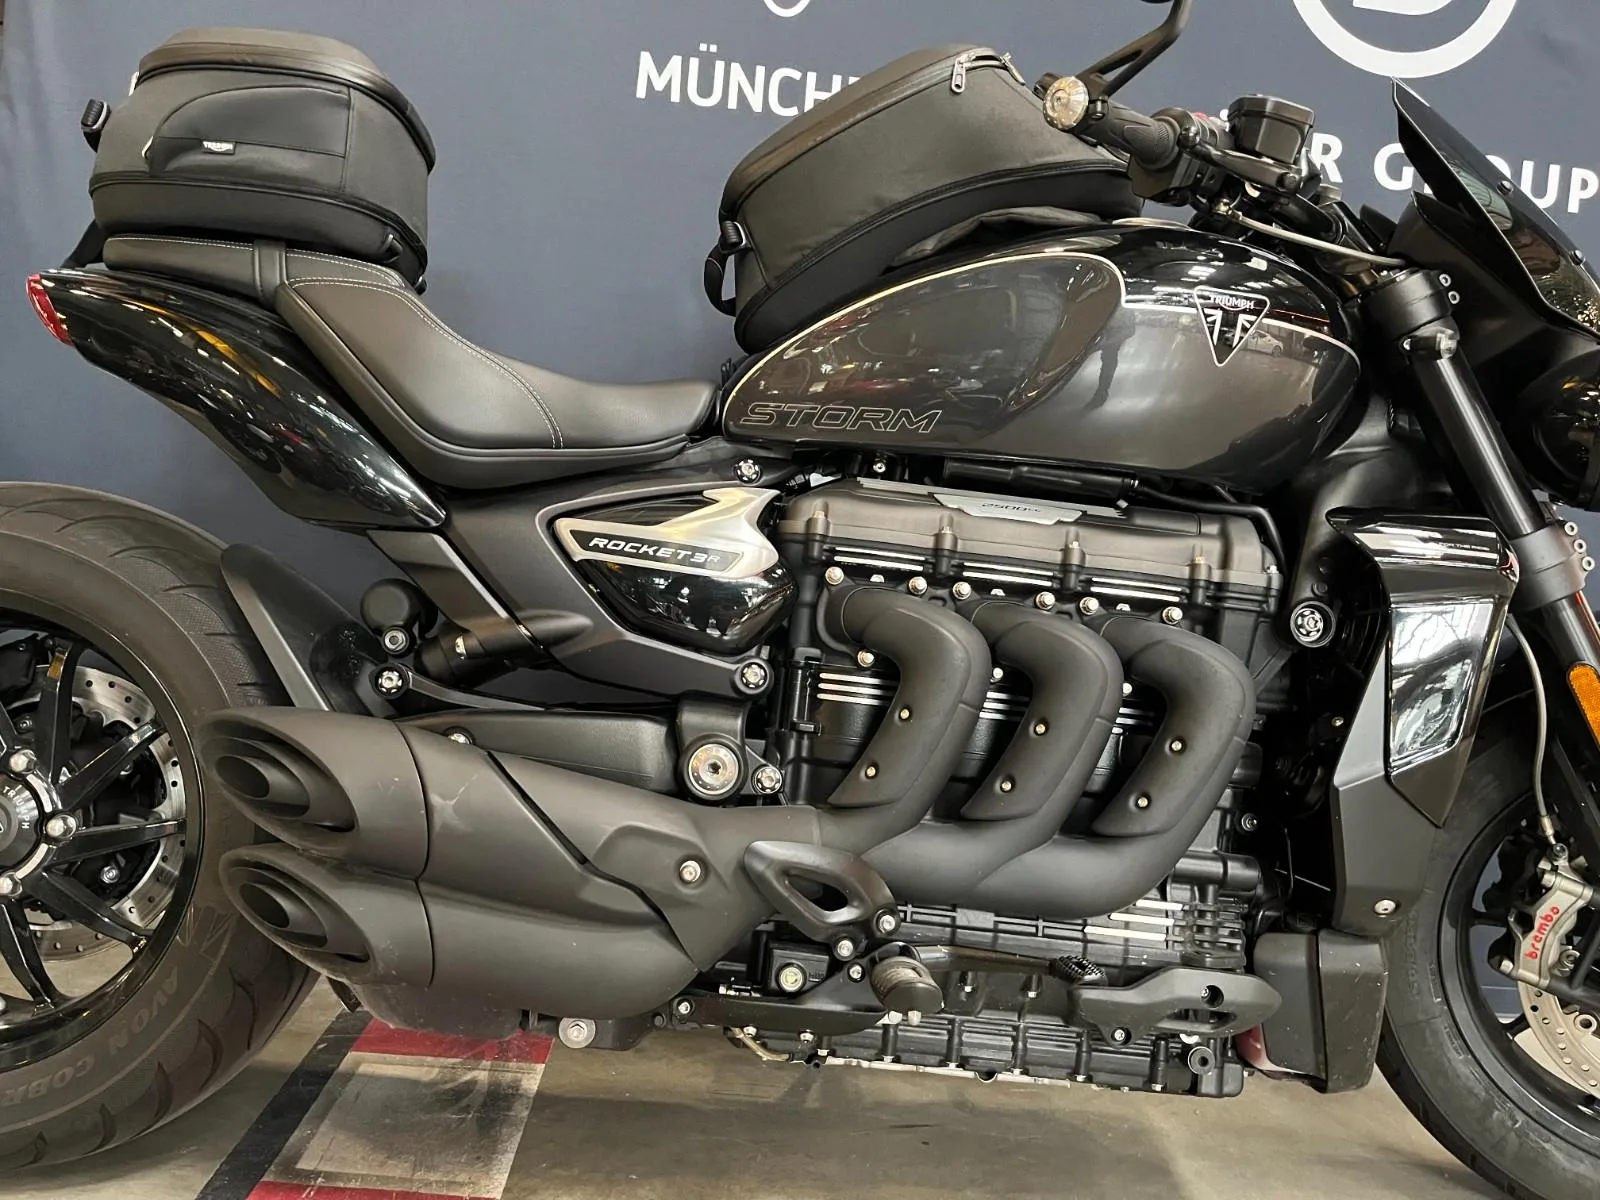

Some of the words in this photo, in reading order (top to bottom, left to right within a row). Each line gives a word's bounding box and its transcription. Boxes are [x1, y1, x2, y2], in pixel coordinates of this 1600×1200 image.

[636, 43, 860, 117] MÜNCH
[1373, 142, 1599, 214] GUP
[1209, 294, 1255, 311] TRIUMPH
[739, 402, 943, 433] STORM
[1524, 906, 1560, 960] brembo
[108, 965, 178, 1055] AVON
